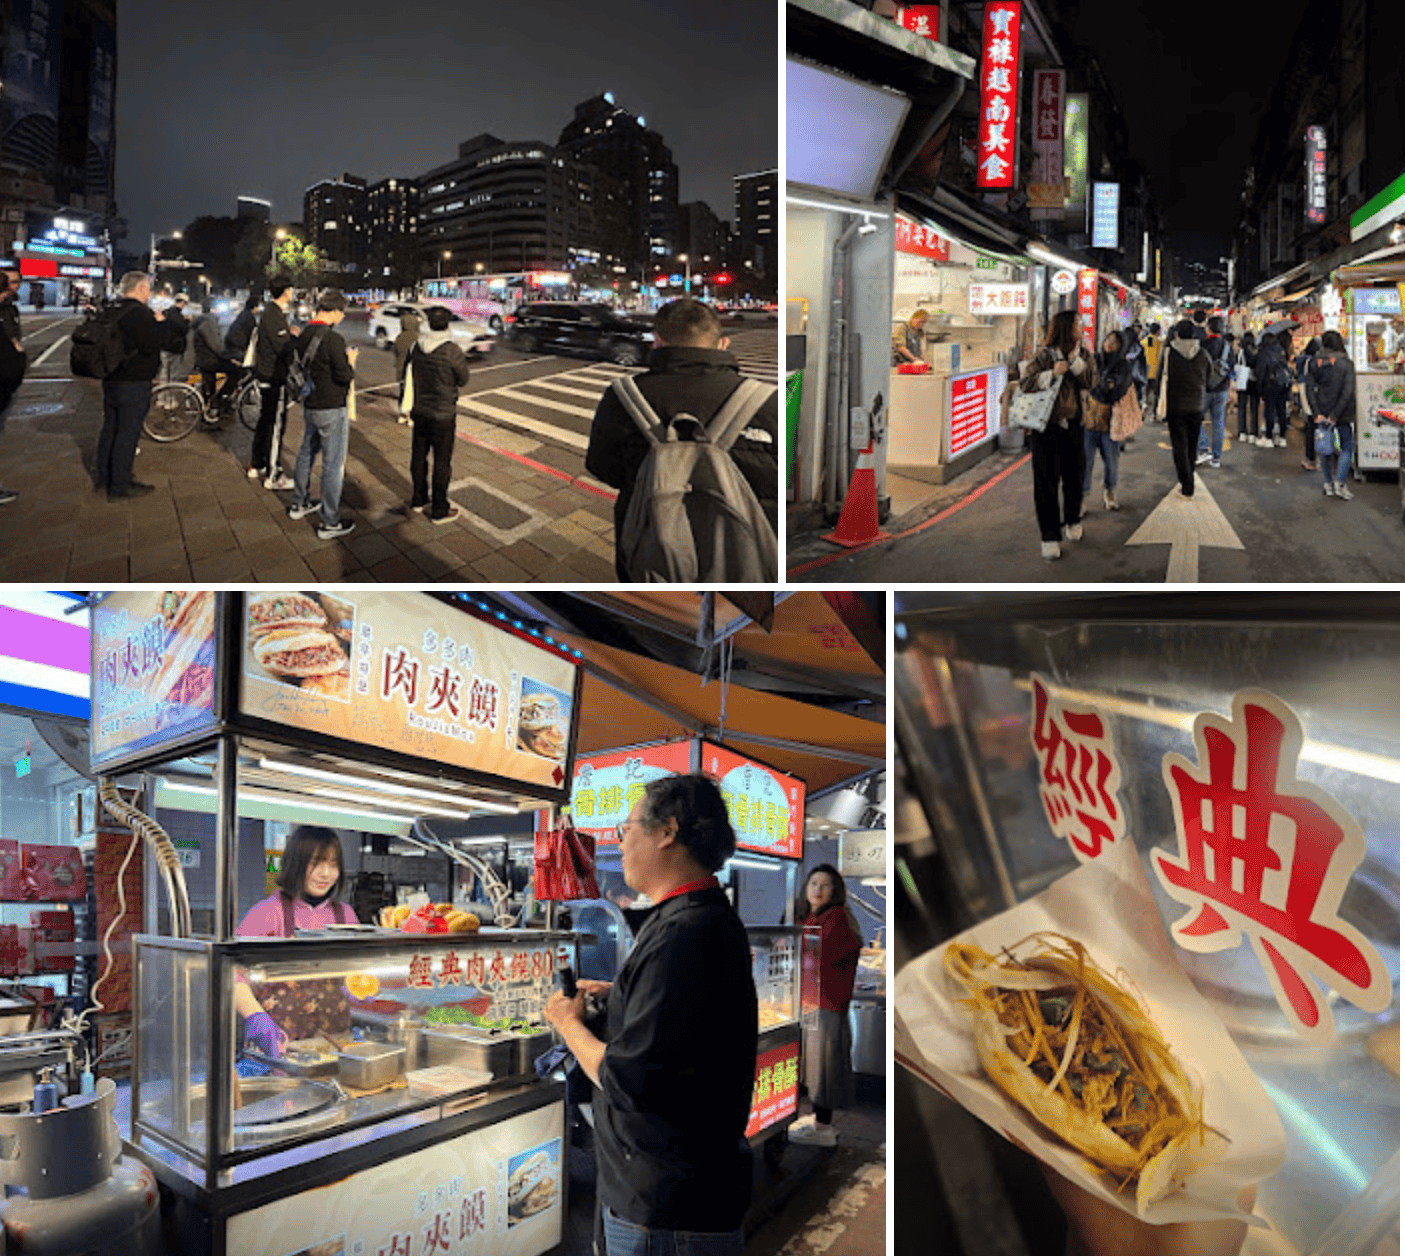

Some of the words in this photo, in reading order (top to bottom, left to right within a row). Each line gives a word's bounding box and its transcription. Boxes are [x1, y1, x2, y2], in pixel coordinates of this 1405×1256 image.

[382, 650, 498, 730] 肉夾饃
[1034, 679, 1370, 1028] 經典
